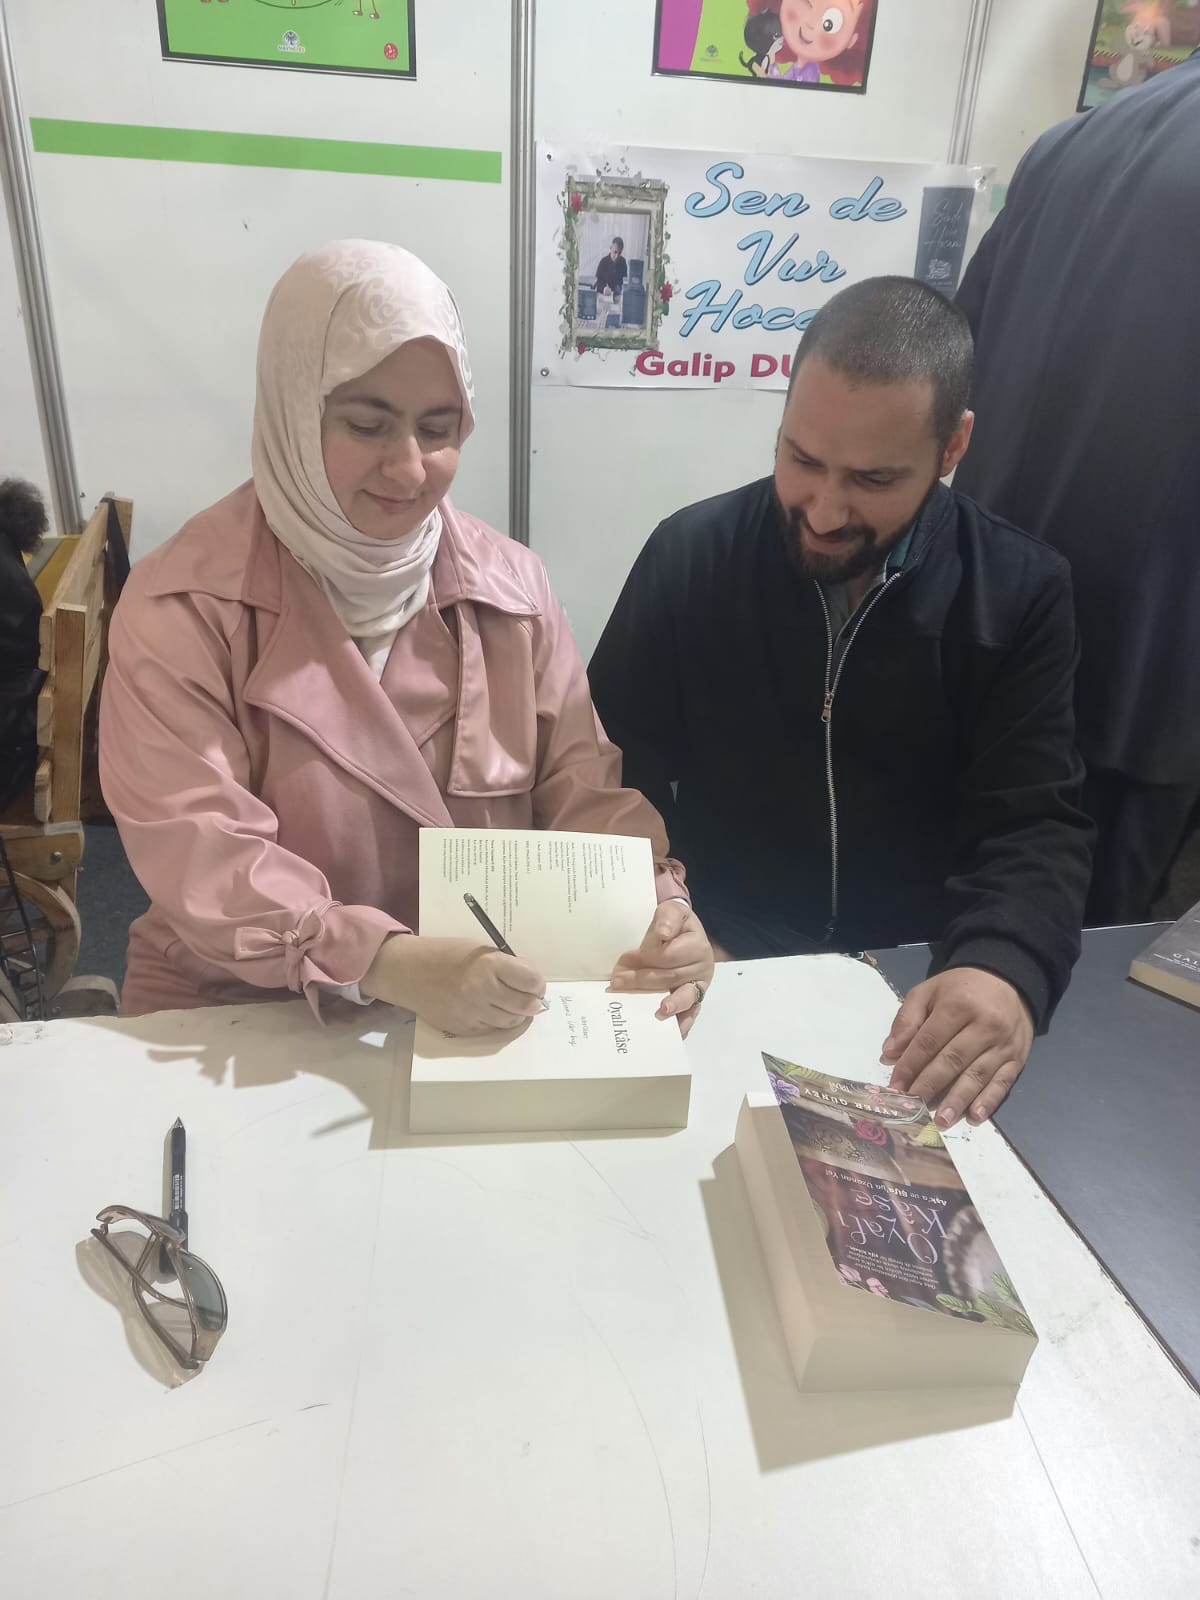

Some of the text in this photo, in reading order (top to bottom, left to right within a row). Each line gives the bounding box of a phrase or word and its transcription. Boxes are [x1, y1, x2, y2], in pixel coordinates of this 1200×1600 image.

[685, 161, 810, 219] Sen
[829, 176, 908, 222] de
[736, 229, 847, 286] Vur
[635, 350, 736, 383] Galip
[608, 1001, 631, 1054] Oyalı Kâse
[853, 1101, 899, 1117] AYFER
